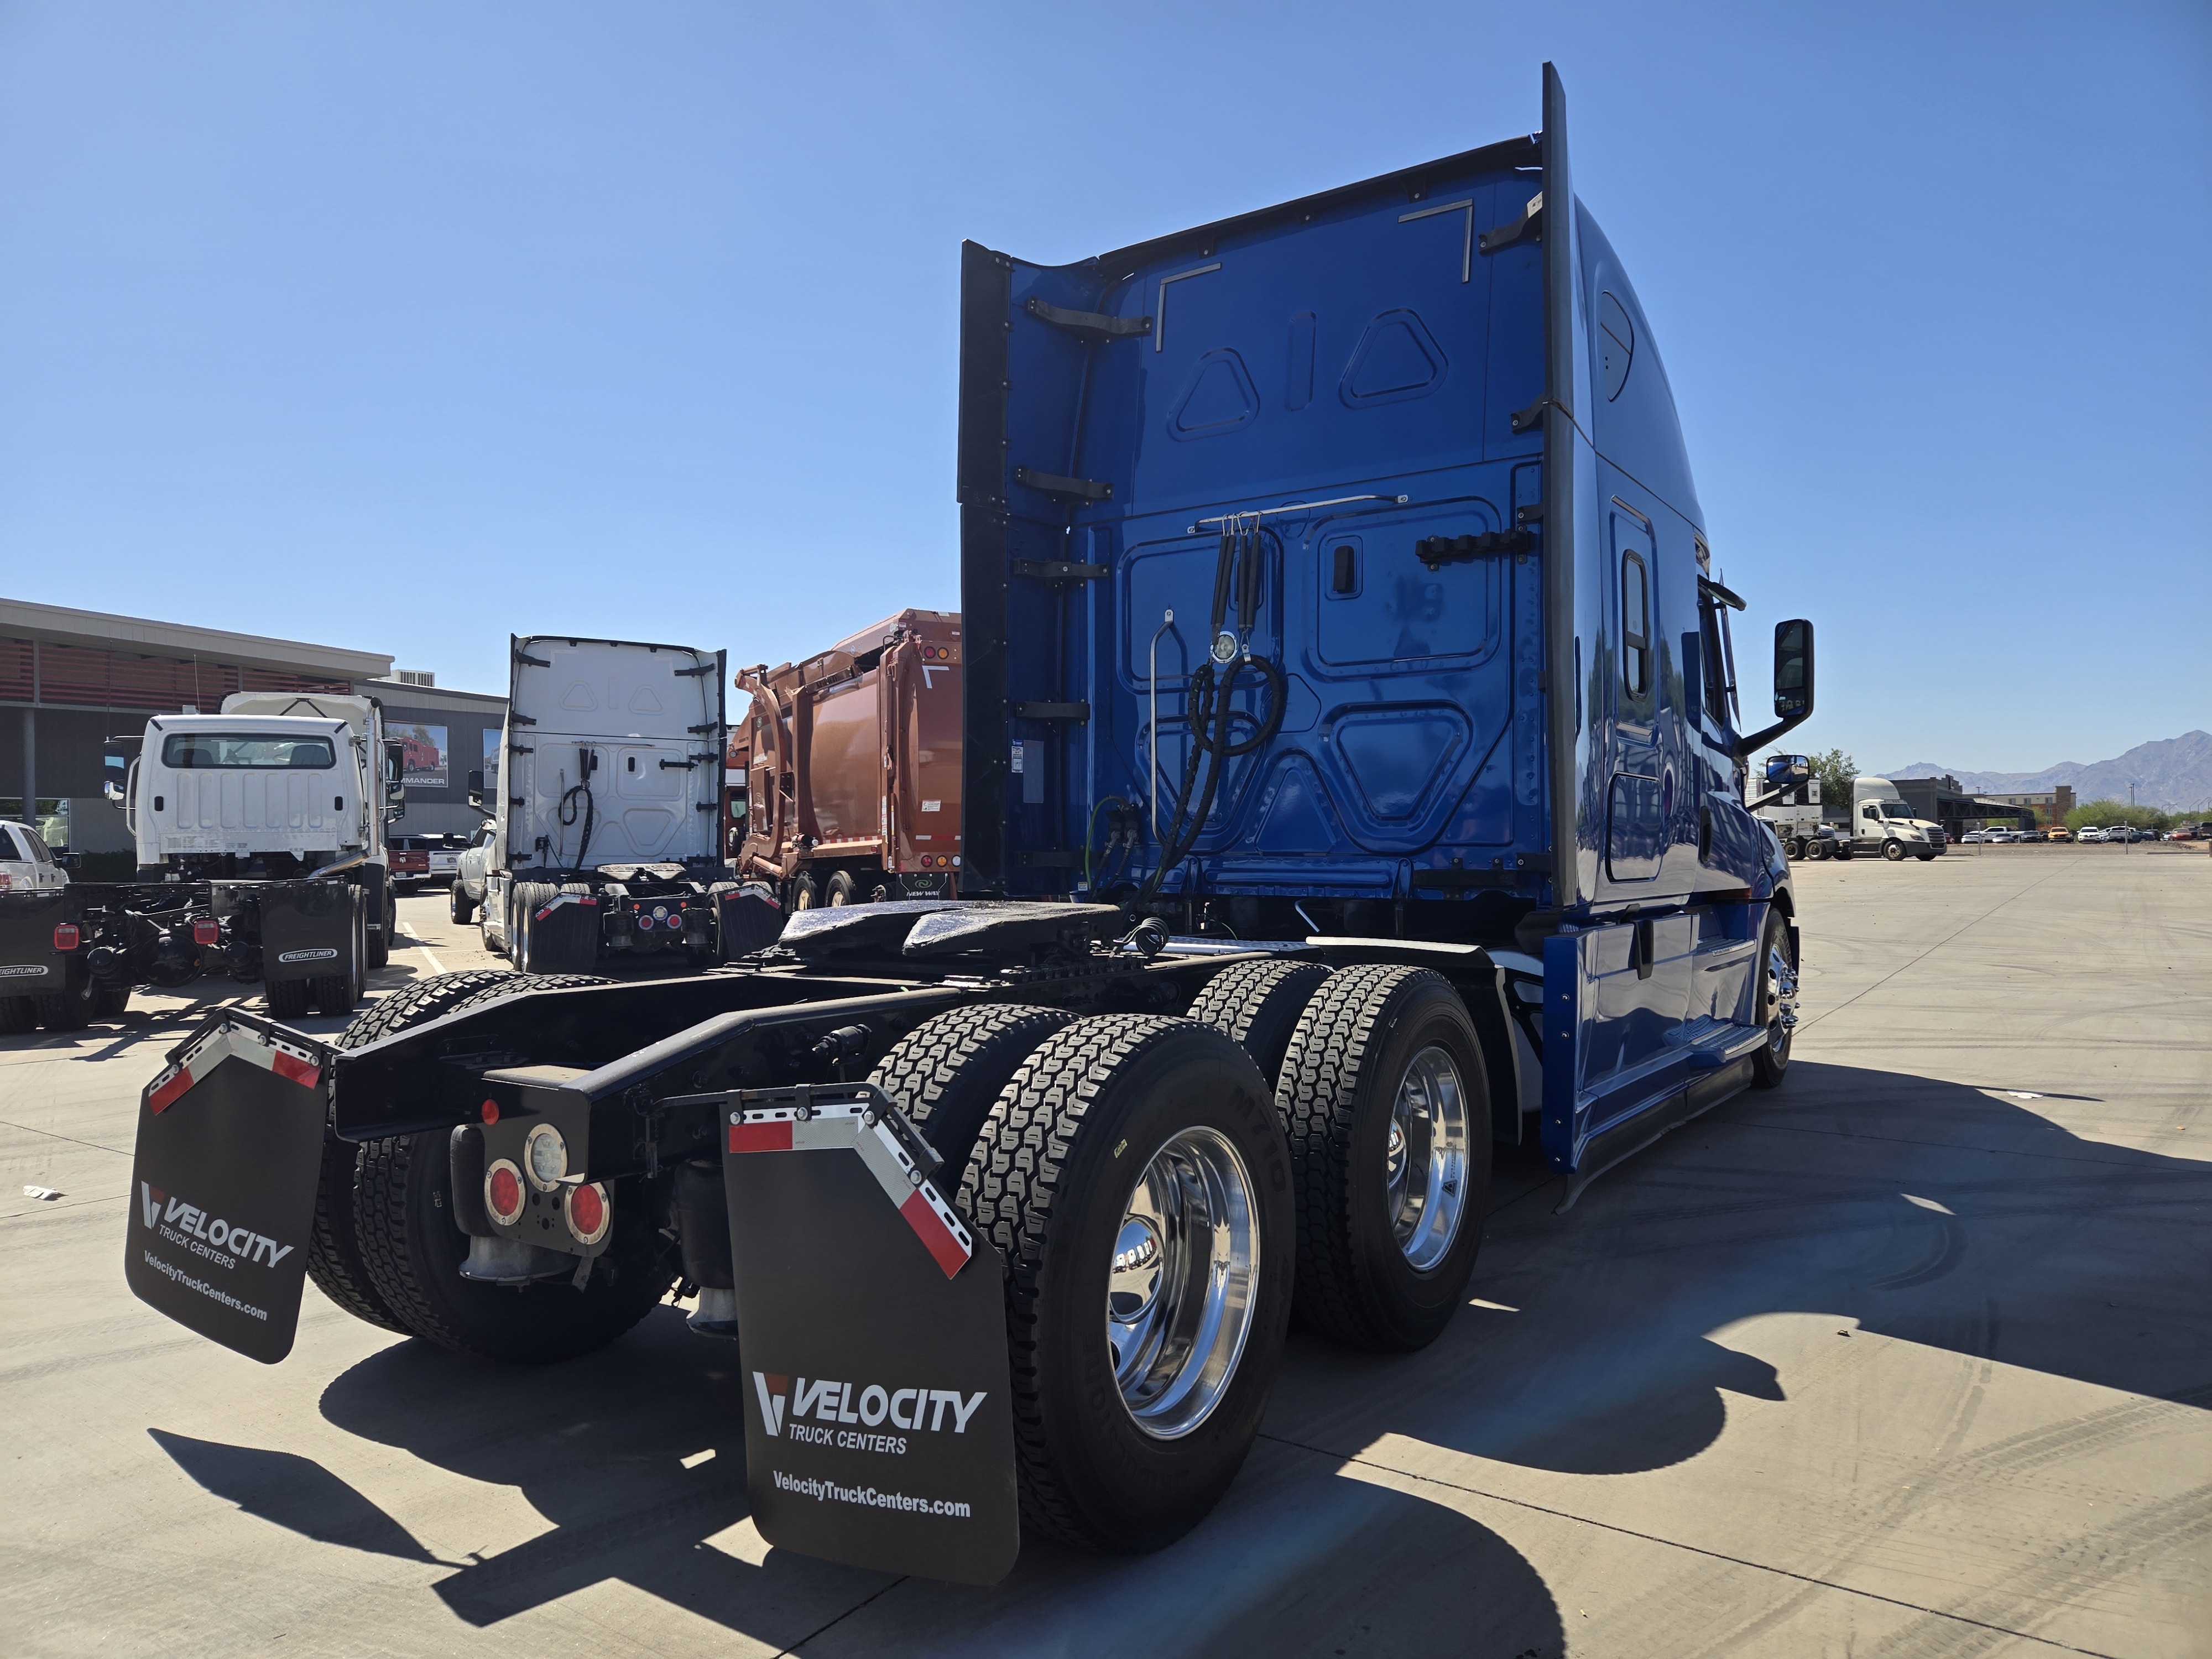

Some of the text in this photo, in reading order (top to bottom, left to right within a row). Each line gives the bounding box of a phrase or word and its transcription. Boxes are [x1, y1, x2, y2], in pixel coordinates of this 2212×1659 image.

[0, 967, 42, 975] EIGHTLINER
[284, 951, 332, 961] FREIGHTLINER
[1228, 1083, 1287, 1194] M710
[159, 1224, 236, 1269] TRUCK CENTERS
[164, 1197, 295, 1268] VELOCITY
[144, 1250, 268, 1321] VelocityTruckCenters.com
[792, 1378, 988, 1433] VELOCITY
[789, 1423, 907, 1454] TRUCK CENTERS
[773, 1470, 971, 1517] VelocityTruckCenters.com
